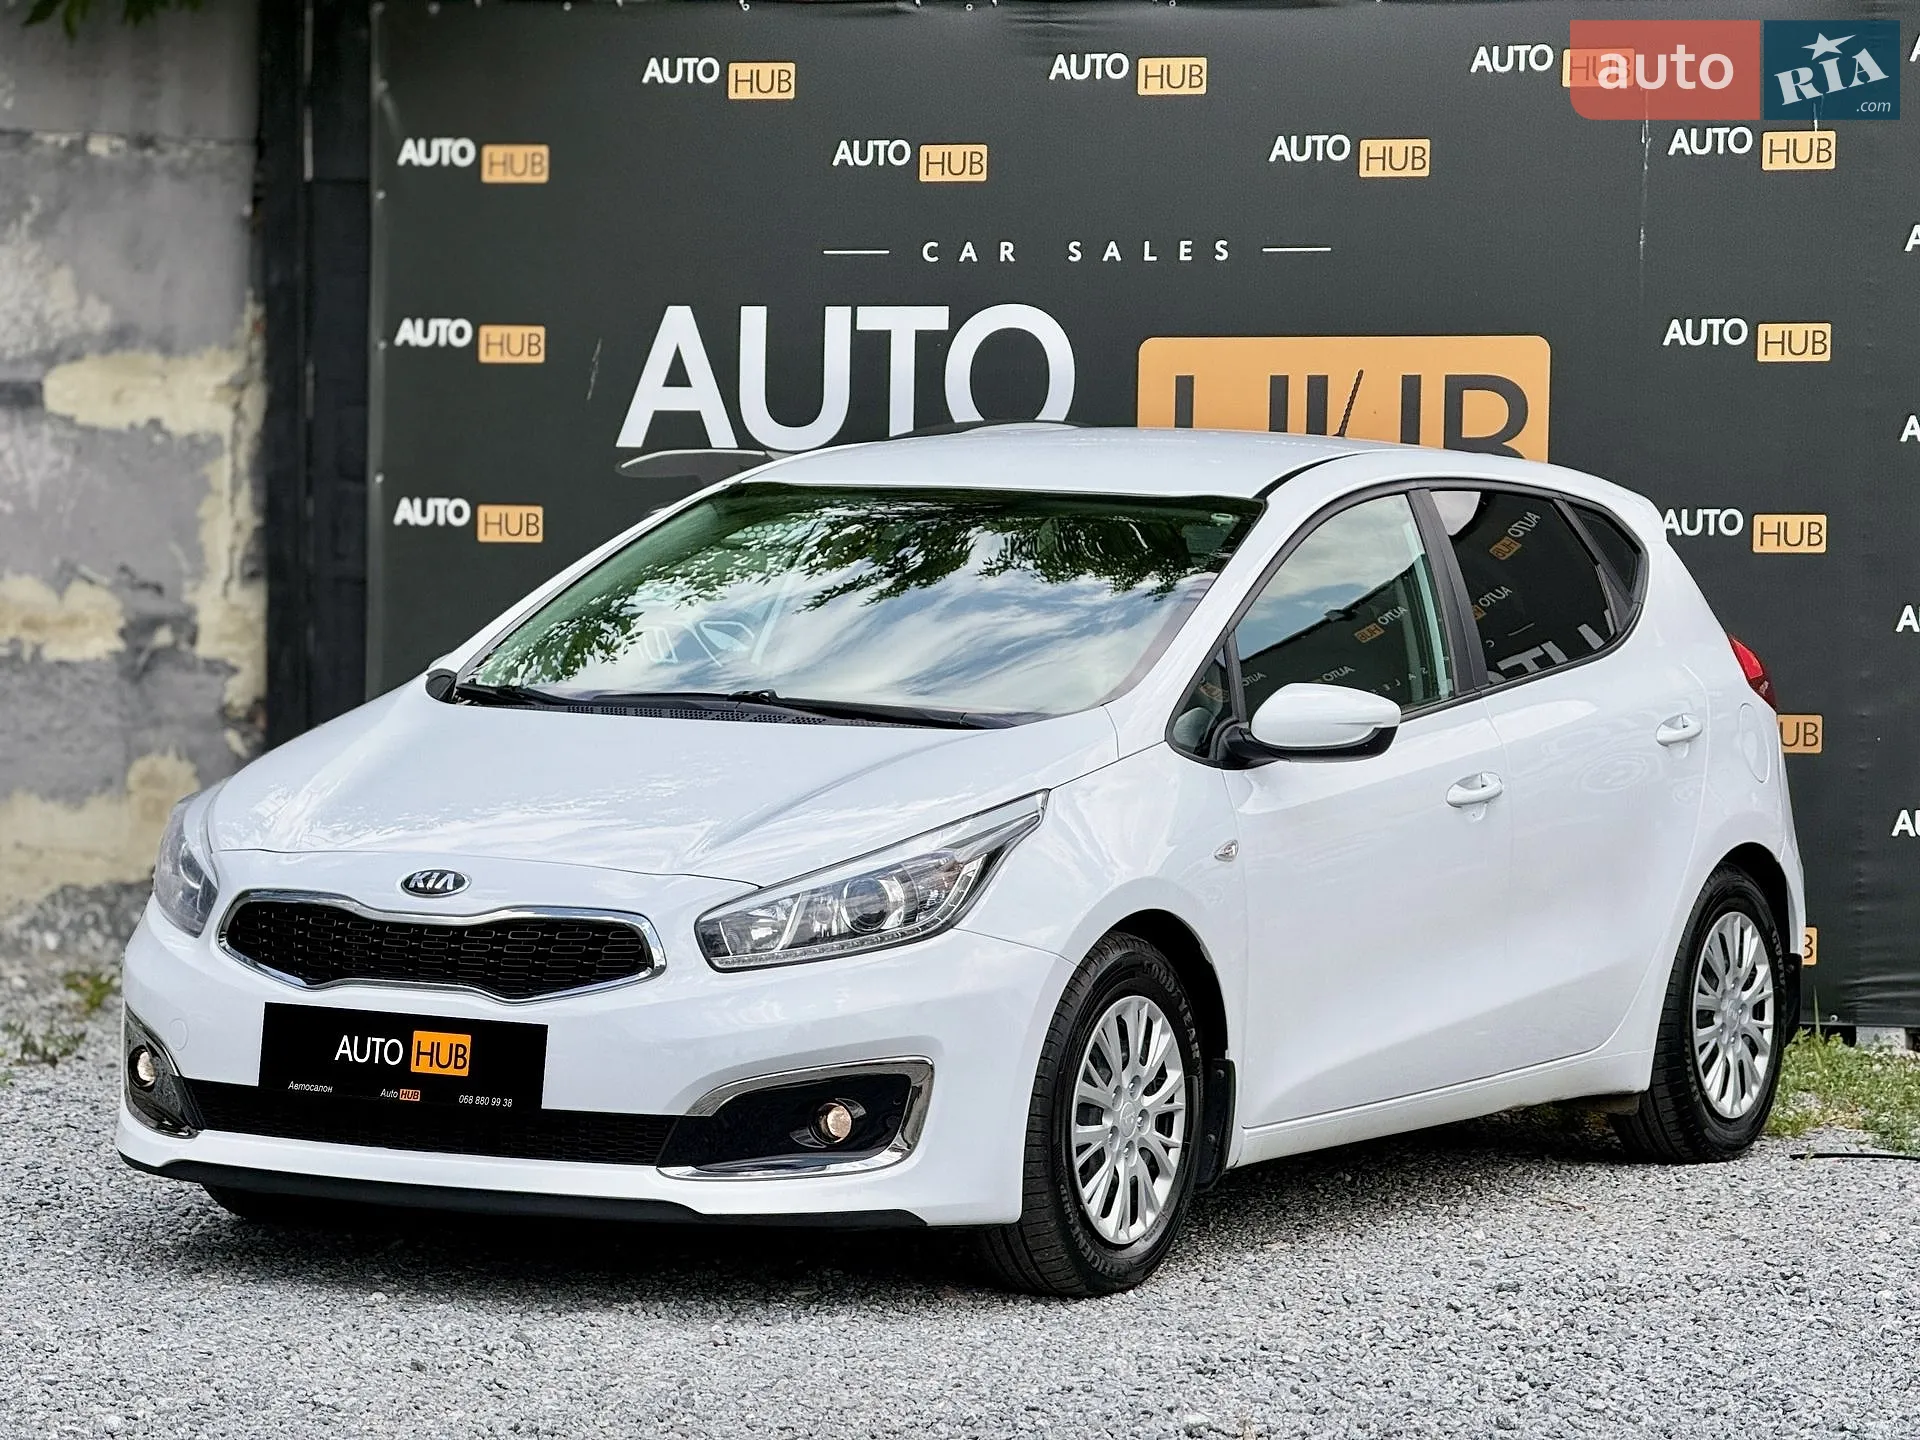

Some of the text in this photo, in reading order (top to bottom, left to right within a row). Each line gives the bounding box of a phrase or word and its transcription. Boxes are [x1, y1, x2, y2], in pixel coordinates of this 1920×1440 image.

[642, 56, 792, 94] AUTO HUB
[1049, 52, 1204, 89] AUTO HUB
[1470, 43, 1554, 73] AUTO
[397, 138, 546, 177] AUTO HUB
[832, 139, 984, 176] AUTO HUB
[1268, 134, 1427, 171] AUTO HUB
[1668, 126, 1833, 164] AUTO HUB
[922, 239, 1229, 263] CAR SALES
[395, 318, 542, 357] AUTO HUB
[1662, 318, 1828, 356] AUTO HUB
[615, 303, 1076, 451] AUTO
[393, 497, 540, 537] AUTO HUB
[1662, 508, 1823, 547] AUTO HUB
[1780, 721, 1819, 748] UB
[408, 871, 455, 890] KIA
[334, 1034, 468, 1070] AUTO HUB
[287, 1080, 333, 1093] Автосалон
[380, 1088, 420, 1101] Auto HUB
[458, 1094, 513, 1108] 068 880 99 38
